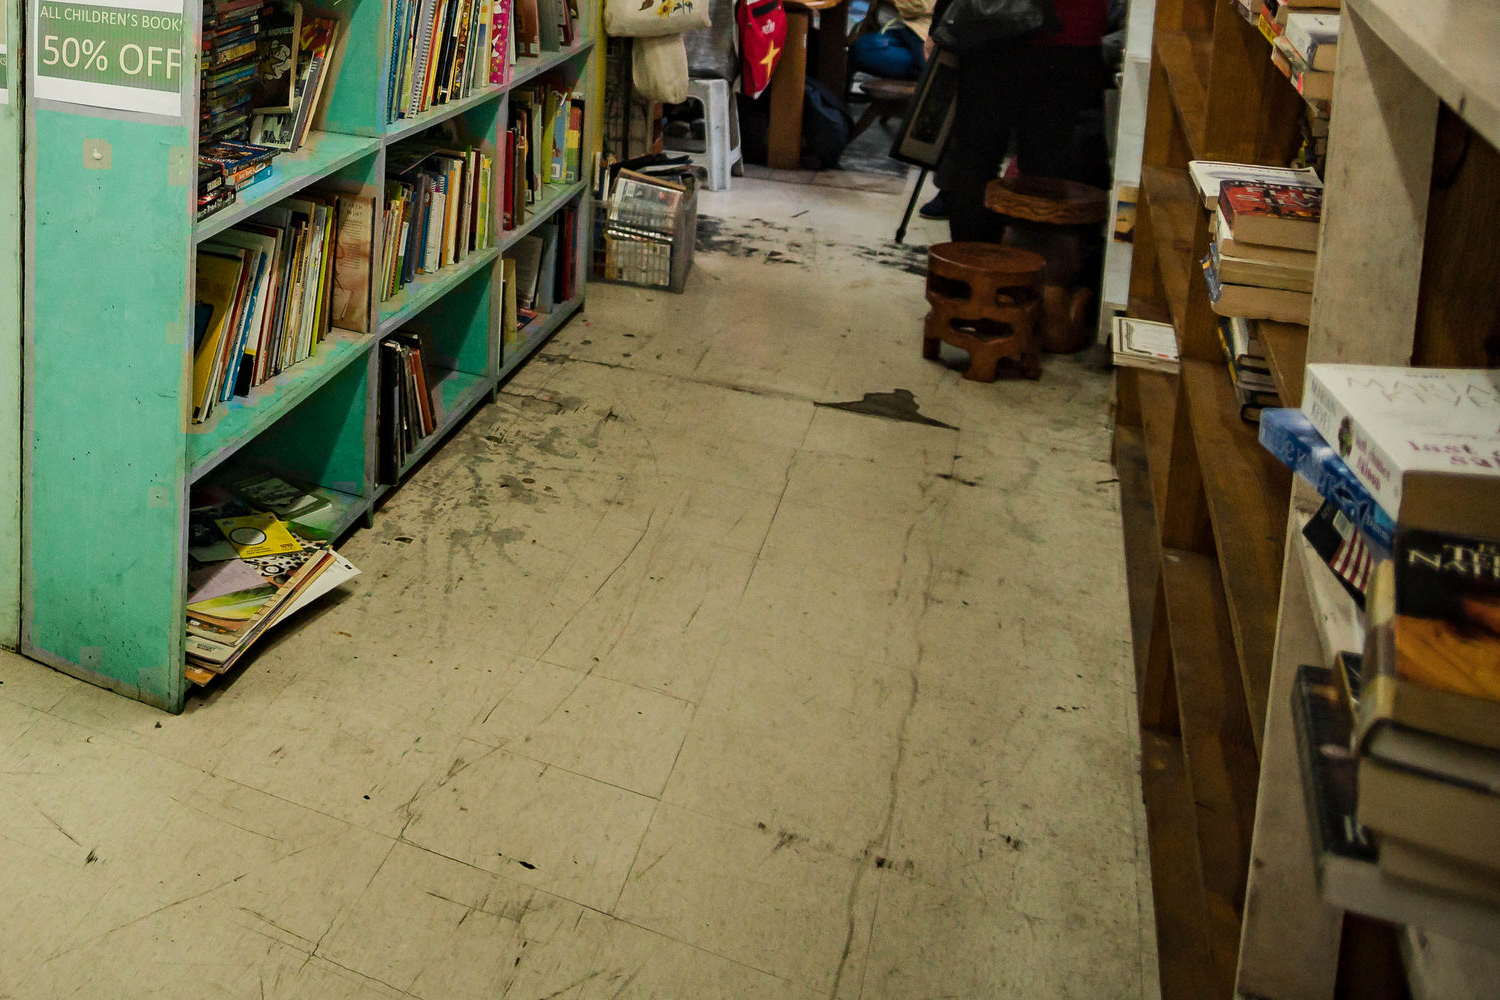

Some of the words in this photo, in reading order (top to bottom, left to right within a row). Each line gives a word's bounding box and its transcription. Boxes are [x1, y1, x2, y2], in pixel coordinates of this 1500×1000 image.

[40, 5, 62, 19] ALL
[64, 8, 138, 28] CHILDREN'S
[43, 35, 108, 72] 50%
[119, 43, 181, 79] OFF
